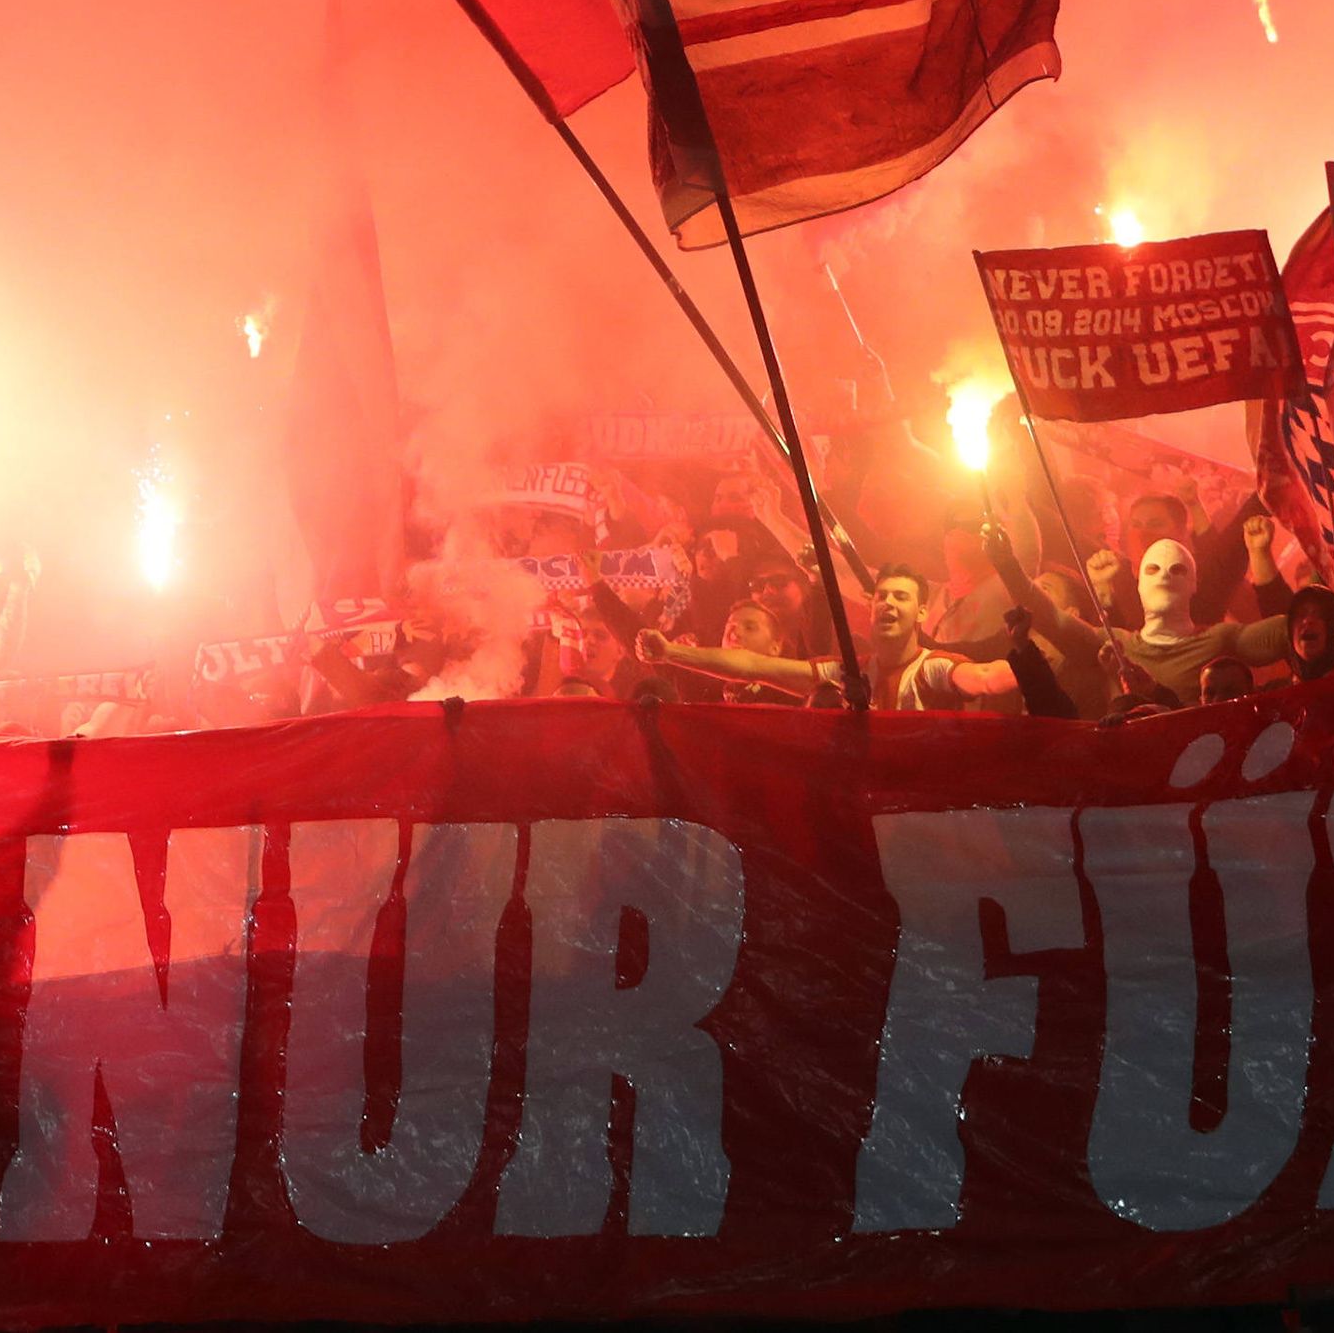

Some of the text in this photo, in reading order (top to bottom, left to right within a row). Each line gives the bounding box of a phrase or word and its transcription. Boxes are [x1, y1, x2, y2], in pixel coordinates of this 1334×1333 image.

[985, 252, 1273, 301] NEVER FORGET!
[0, 815, 747, 1247] NUR
